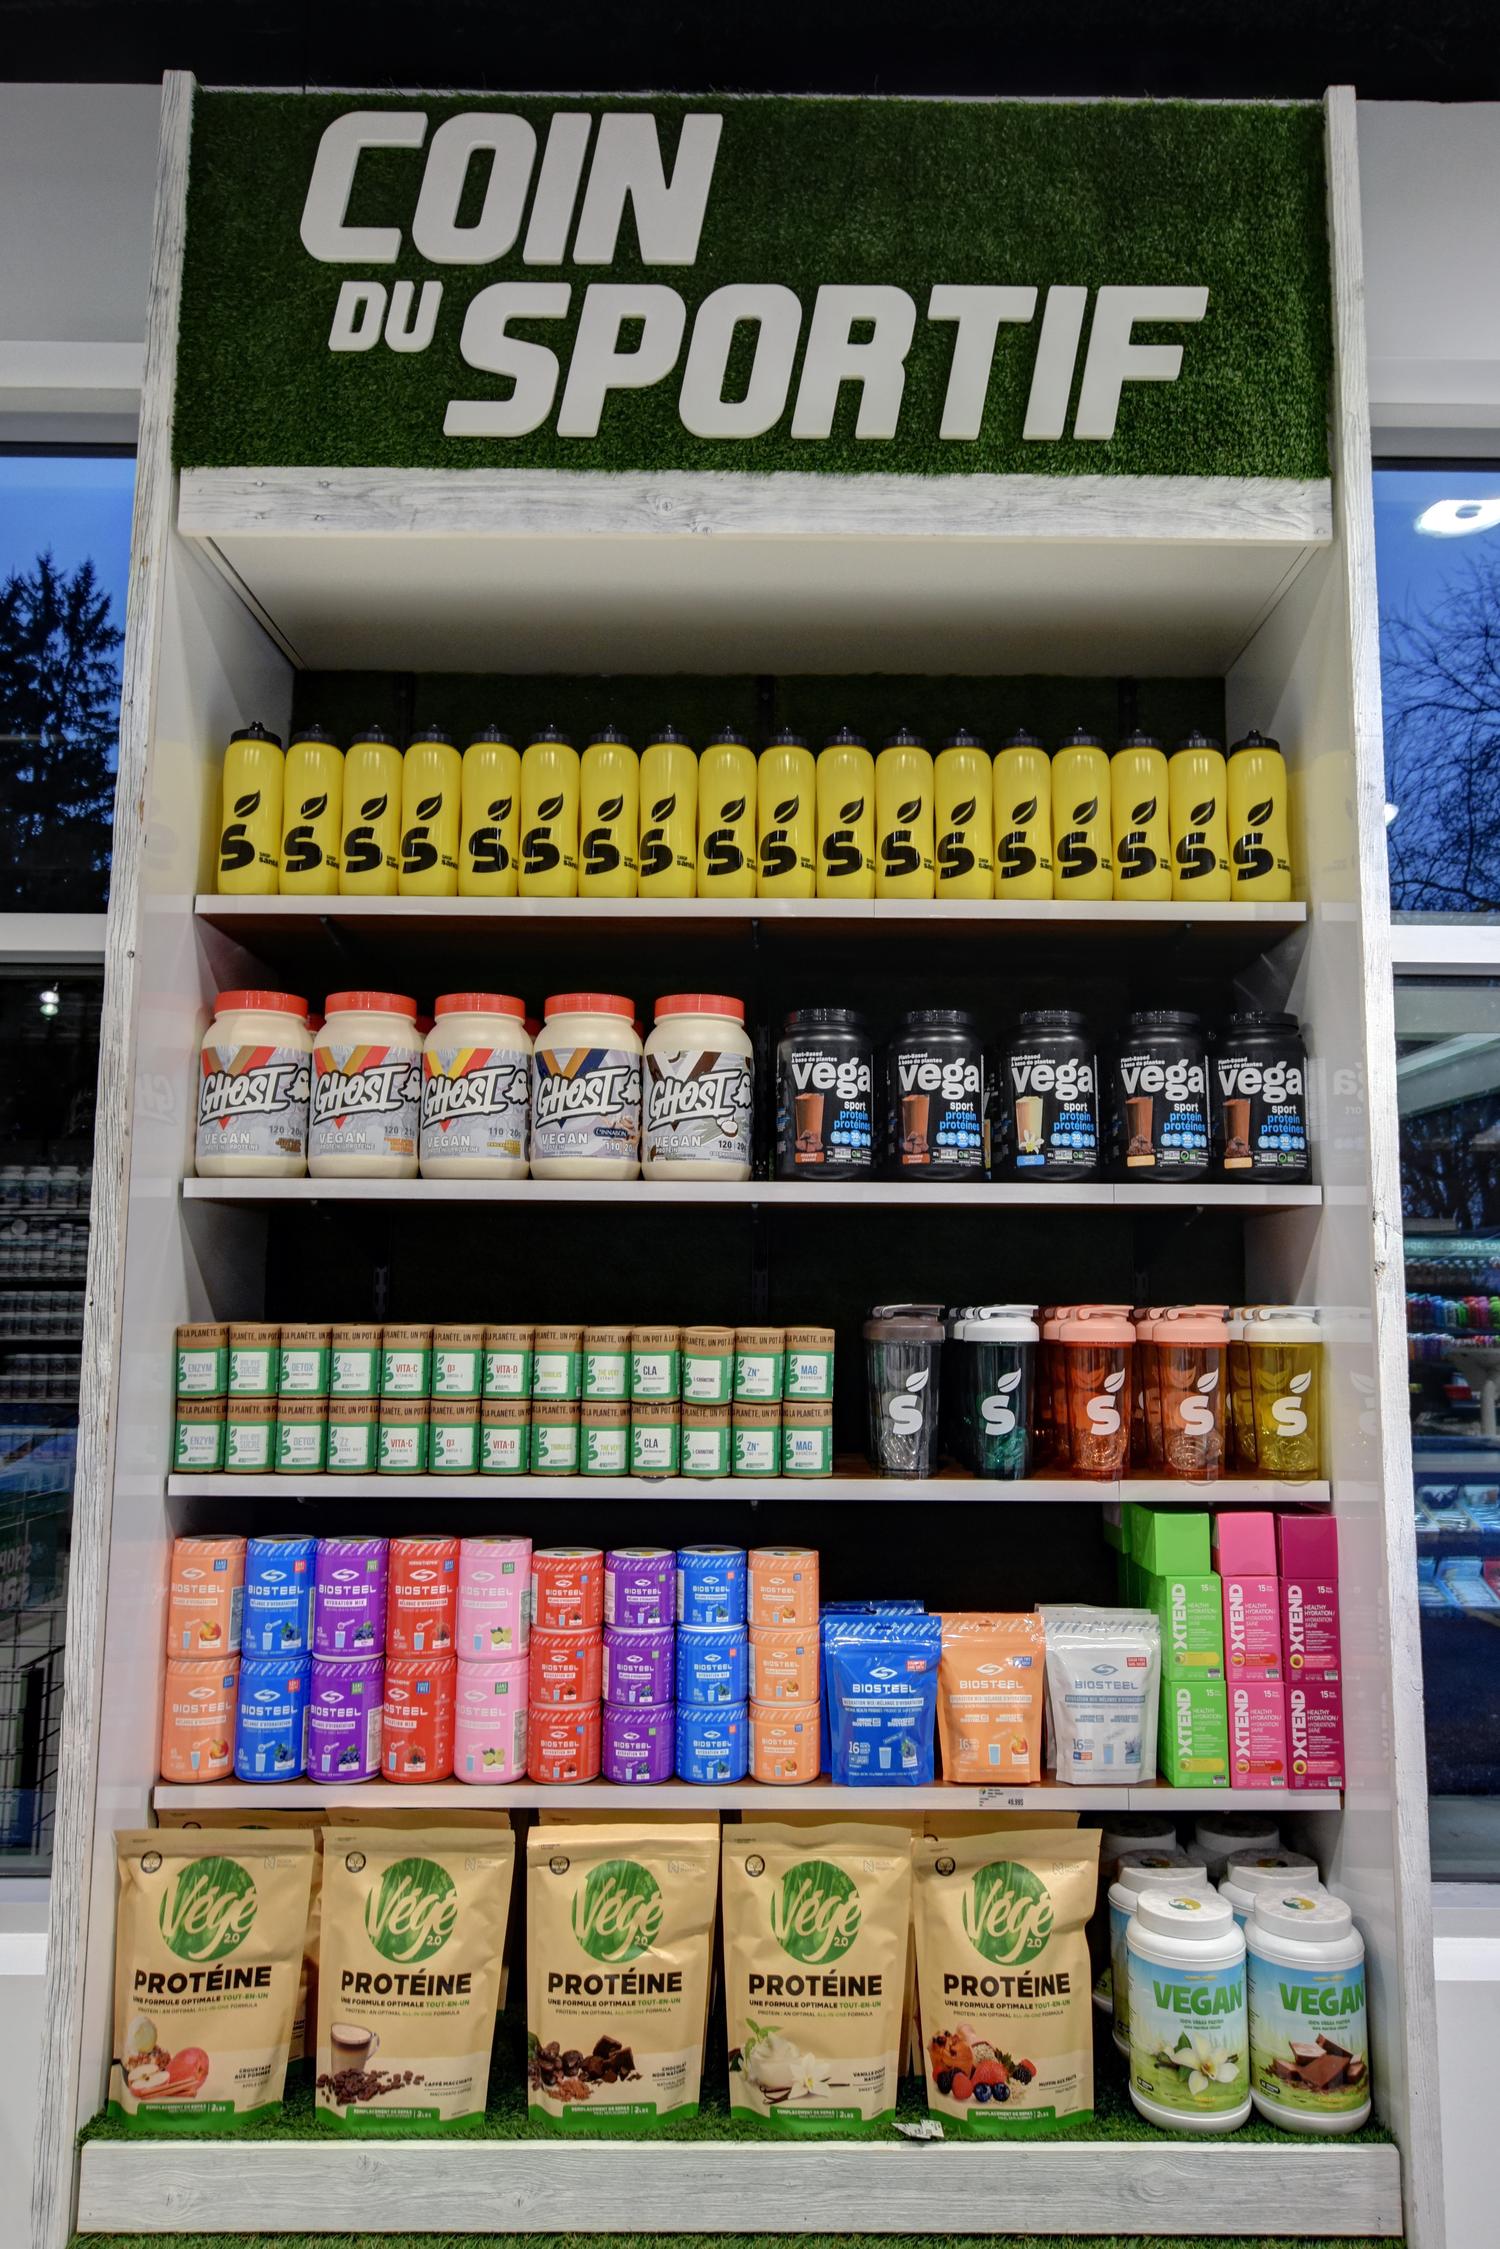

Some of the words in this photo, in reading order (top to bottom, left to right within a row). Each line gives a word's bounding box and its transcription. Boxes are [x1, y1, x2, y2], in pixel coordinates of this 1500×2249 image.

[299, 111, 722, 267] COIN
[328, 279, 443, 354] DU
[442, 282, 1210, 442] SPORTIF
[792, 1058, 870, 1099] vega
[899, 1058, 980, 1099] vega
[1011, 1059, 1093, 1101] vega
[1121, 1059, 1205, 1101] vega
[1219, 1061, 1303, 1103] vega
[200, 1064, 297, 1126] GHOST
[313, 1063, 410, 1126] GHOST
[423, 1065, 515, 1129] GHOST
[536, 1065, 630, 1128] GHOST
[649, 1069, 742, 1131] GHOST
[844, 1101, 866, 1112] sport
[950, 1101, 973, 1112] sport
[1064, 1102, 1087, 1113] sport
[1174, 1103, 1198, 1113] sport
[1272, 1104, 1297, 1115] sport
[840, 1110, 868, 1122] protein
[946, 1110, 976, 1122] protein
[1060, 1112, 1091, 1122] protein
[1170, 1112, 1202, 1122] protein
[1267, 1113, 1300, 1124] protein
[270, 1125, 284, 1134] 120
[384, 1126, 399, 1134] 120
[834, 1119, 871, 1131] protéines
[939, 1119, 979, 1131] protéines
[1054, 1120, 1094, 1131] protéines
[1164, 1121, 1205, 1132] protéines
[1261, 1123, 1304, 1134] protéines
[489, 1127, 504, 1136] 110
[205, 1132, 250, 1145] VEGAN
[320, 1132, 366, 1145] VEGAN
[426, 1135, 470, 1147] VEGAN
[542, 1133, 588, 1145] VEGAN
[655, 1136, 702, 1148] VEGAN
[718, 1139, 733, 1149] 120
[396, 1364, 418, 1373] VITA-C
[496, 1365, 518, 1374] VITA-D
[643, 1366, 657, 1376] CLA
[801, 1366, 818, 1375] MAG
[493, 1440, 515, 1449] VITA-D
[644, 1438, 658, 1448] CLA
[796, 1441, 812, 1451] MAG
[248, 1584, 304, 1596] BIOSTEEL
[319, 1584, 376, 1595] BIOSTEEL
[395, 1585, 452, 1595] BIOSTEEL
[1201, 1584, 1209, 1592] 15
[1172, 1584, 1188, 1650] XTEND
[1229, 1584, 1246, 1651] XTEND
[1288, 1585, 1305, 1652] XTEND
[853, 1683, 917, 1693] BIOSTEEL
[959, 1680, 1023, 1689] BIOSTEEL
[1074, 1680, 1138, 1690] BIOSTEEL
[1321, 1690, 1329, 1698] 15
[242, 1705, 297, 1715] BIOSTEEL
[1177, 1689, 1193, 1756] XTEND
[1234, 1689, 1251, 1757] XTEND
[1291, 1690, 1308, 1758] XTEND
[224, 1933, 240, 1944] 2.0
[426, 1935, 442, 1946] 2.0
[634, 1936, 648, 1947] 2.0
[834, 1937, 849, 1948] 2.0
[1026, 1938, 1042, 1949] 2.0
[135, 1963, 272, 1994] PROTÉINE
[342, 1968, 471, 1997] PROTÉINE
[548, 1968, 682, 1995] PROTÉINE
[749, 1969, 882, 1997] PROTÉINE
[943, 1970, 1071, 1998] PROTÉINE
[562, 1999, 597, 2007] FORMULE
[1153, 1980, 1243, 2016] VEGAN
[1279, 1982, 1364, 2016] VEGAN
[801, 2001, 838, 2009] OPTIMALE
[960, 2001, 994, 2009] FORMULE
[996, 2002, 1033, 2010] OPTIMALE
